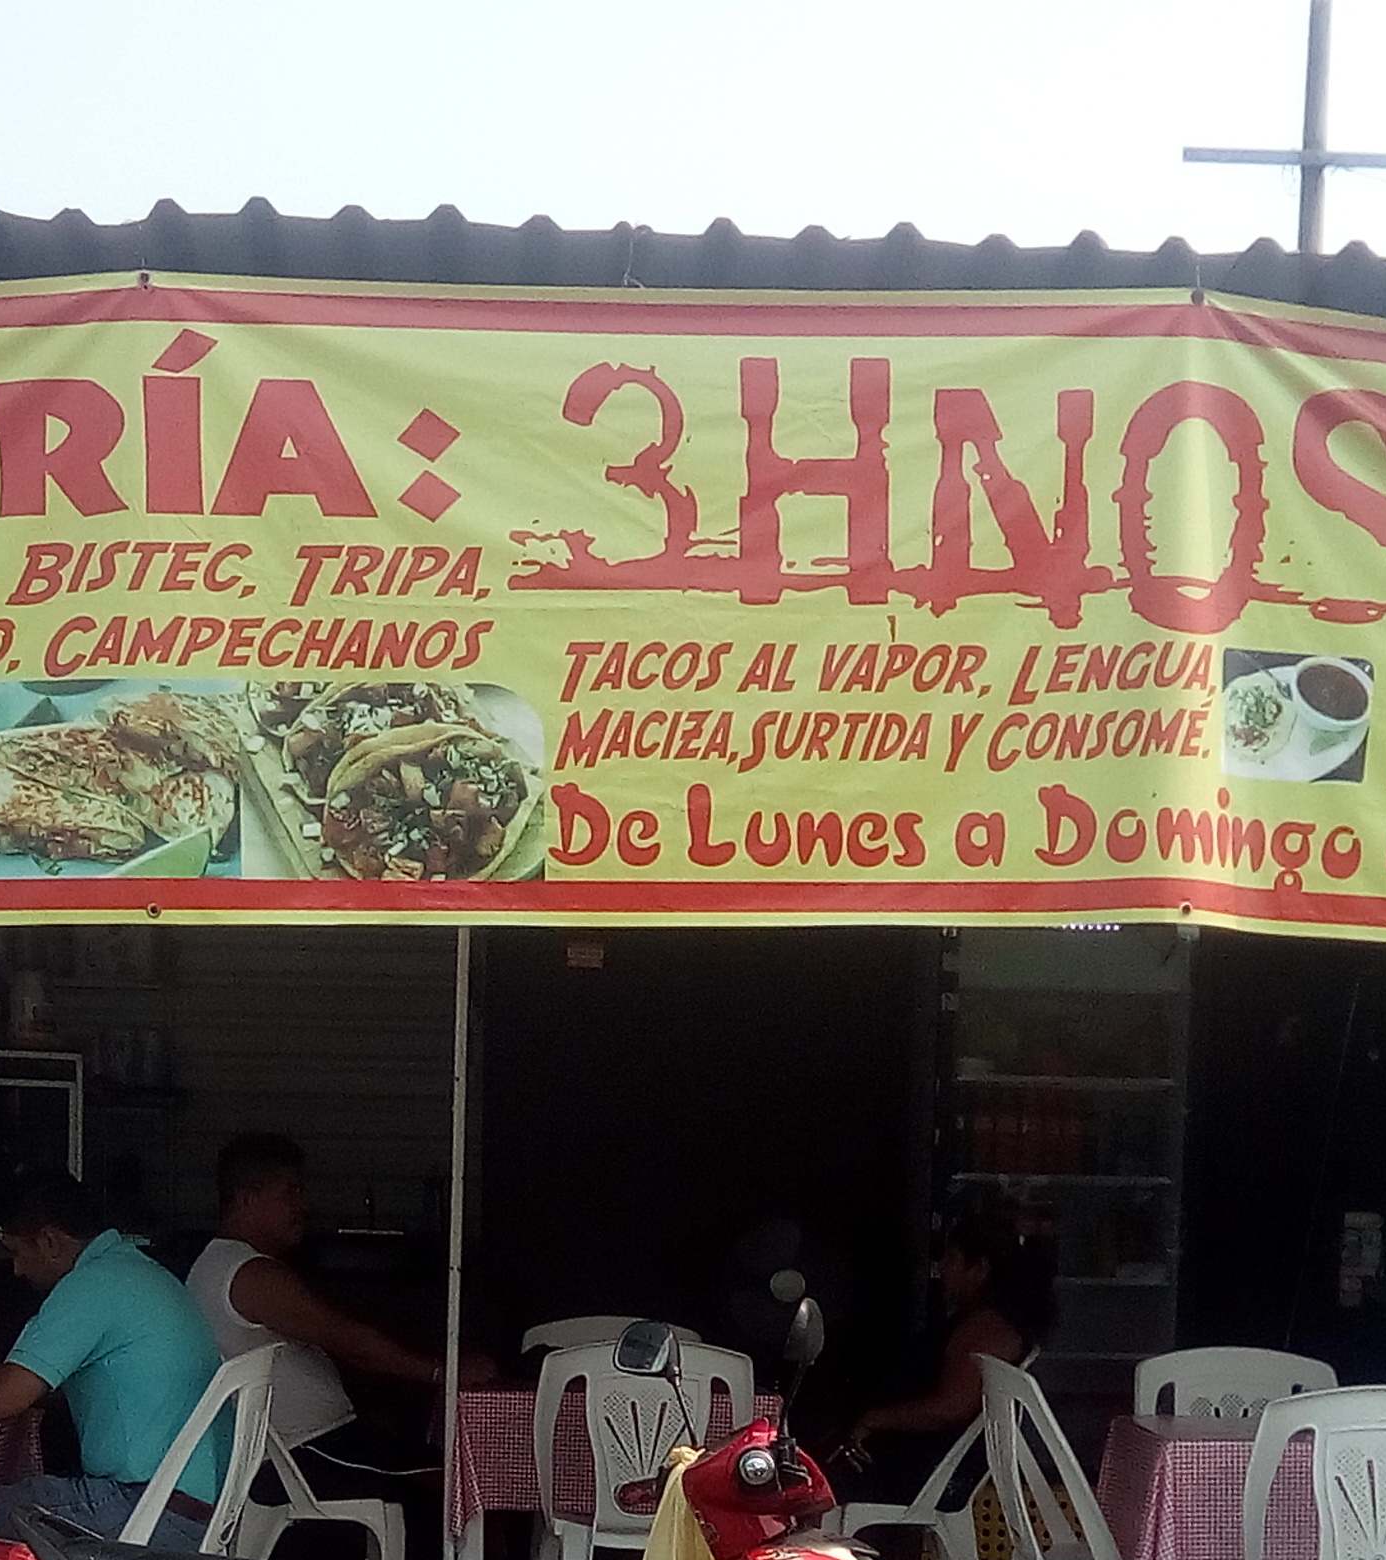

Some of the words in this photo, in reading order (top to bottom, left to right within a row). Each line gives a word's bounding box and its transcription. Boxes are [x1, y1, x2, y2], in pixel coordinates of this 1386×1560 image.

[6, 542, 256, 606] BISTEC,
[290, 545, 490, 606] TRIPA,
[44, 616, 493, 677] CAMPECHANOS
[560, 642, 733, 702] TACOS
[738, 643, 797, 693] AL
[819, 643, 991, 698] VAPOR,
[1009, 642, 1215, 705] LENGUA,
[945, 713, 984, 772] Y
[548, 783, 660, 866] De
[687, 783, 925, 867] Lunes
[955, 812, 1005, 866] a
[1035, 784, 1361, 892] Domingo
